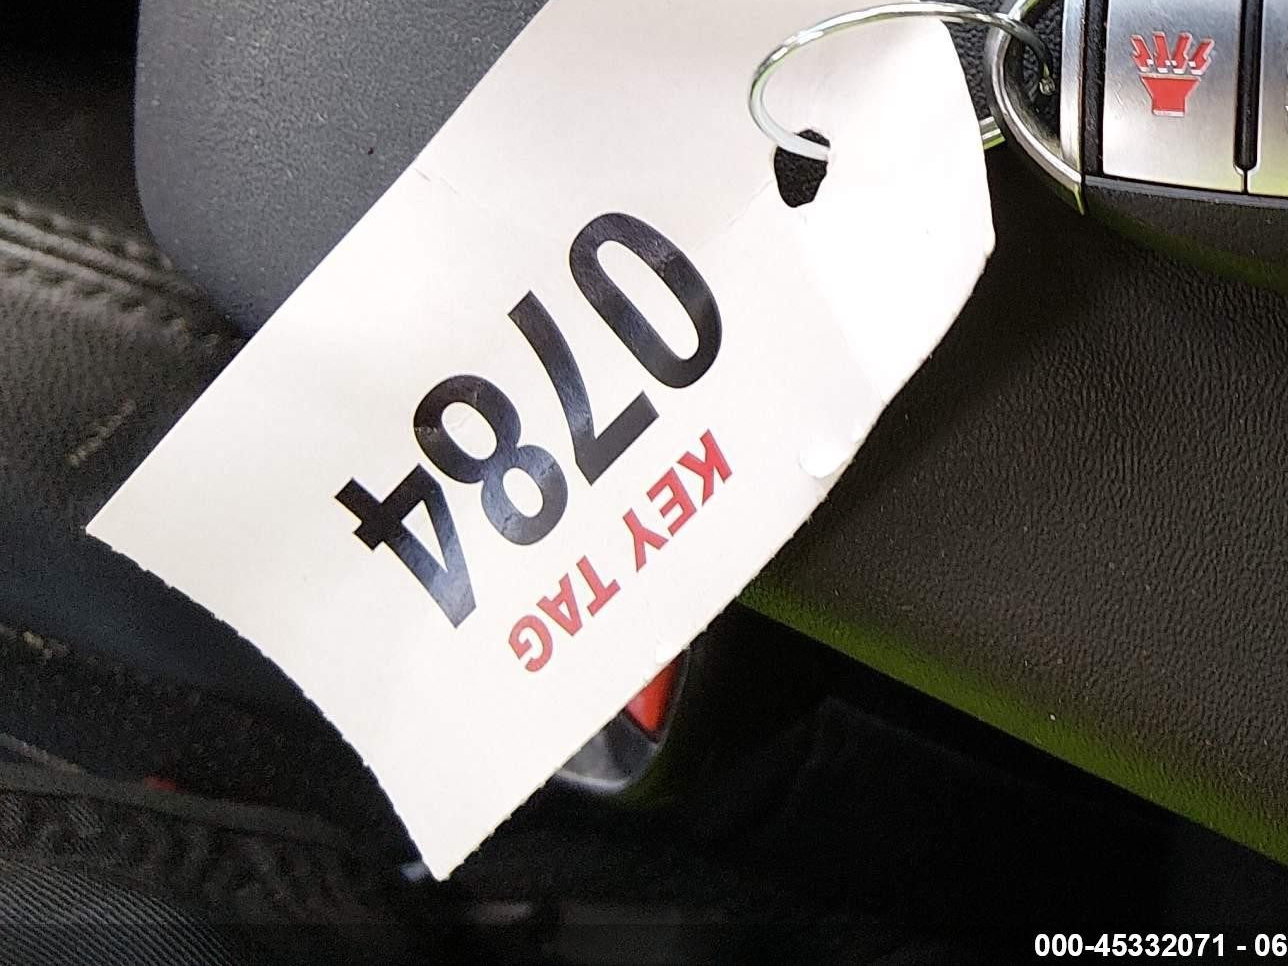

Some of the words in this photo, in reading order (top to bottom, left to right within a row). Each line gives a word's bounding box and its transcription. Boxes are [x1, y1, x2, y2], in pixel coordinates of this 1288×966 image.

[334, 211, 724, 629] 0784
[622, 429, 733, 573] KEY
[508, 555, 621, 673] TAG
